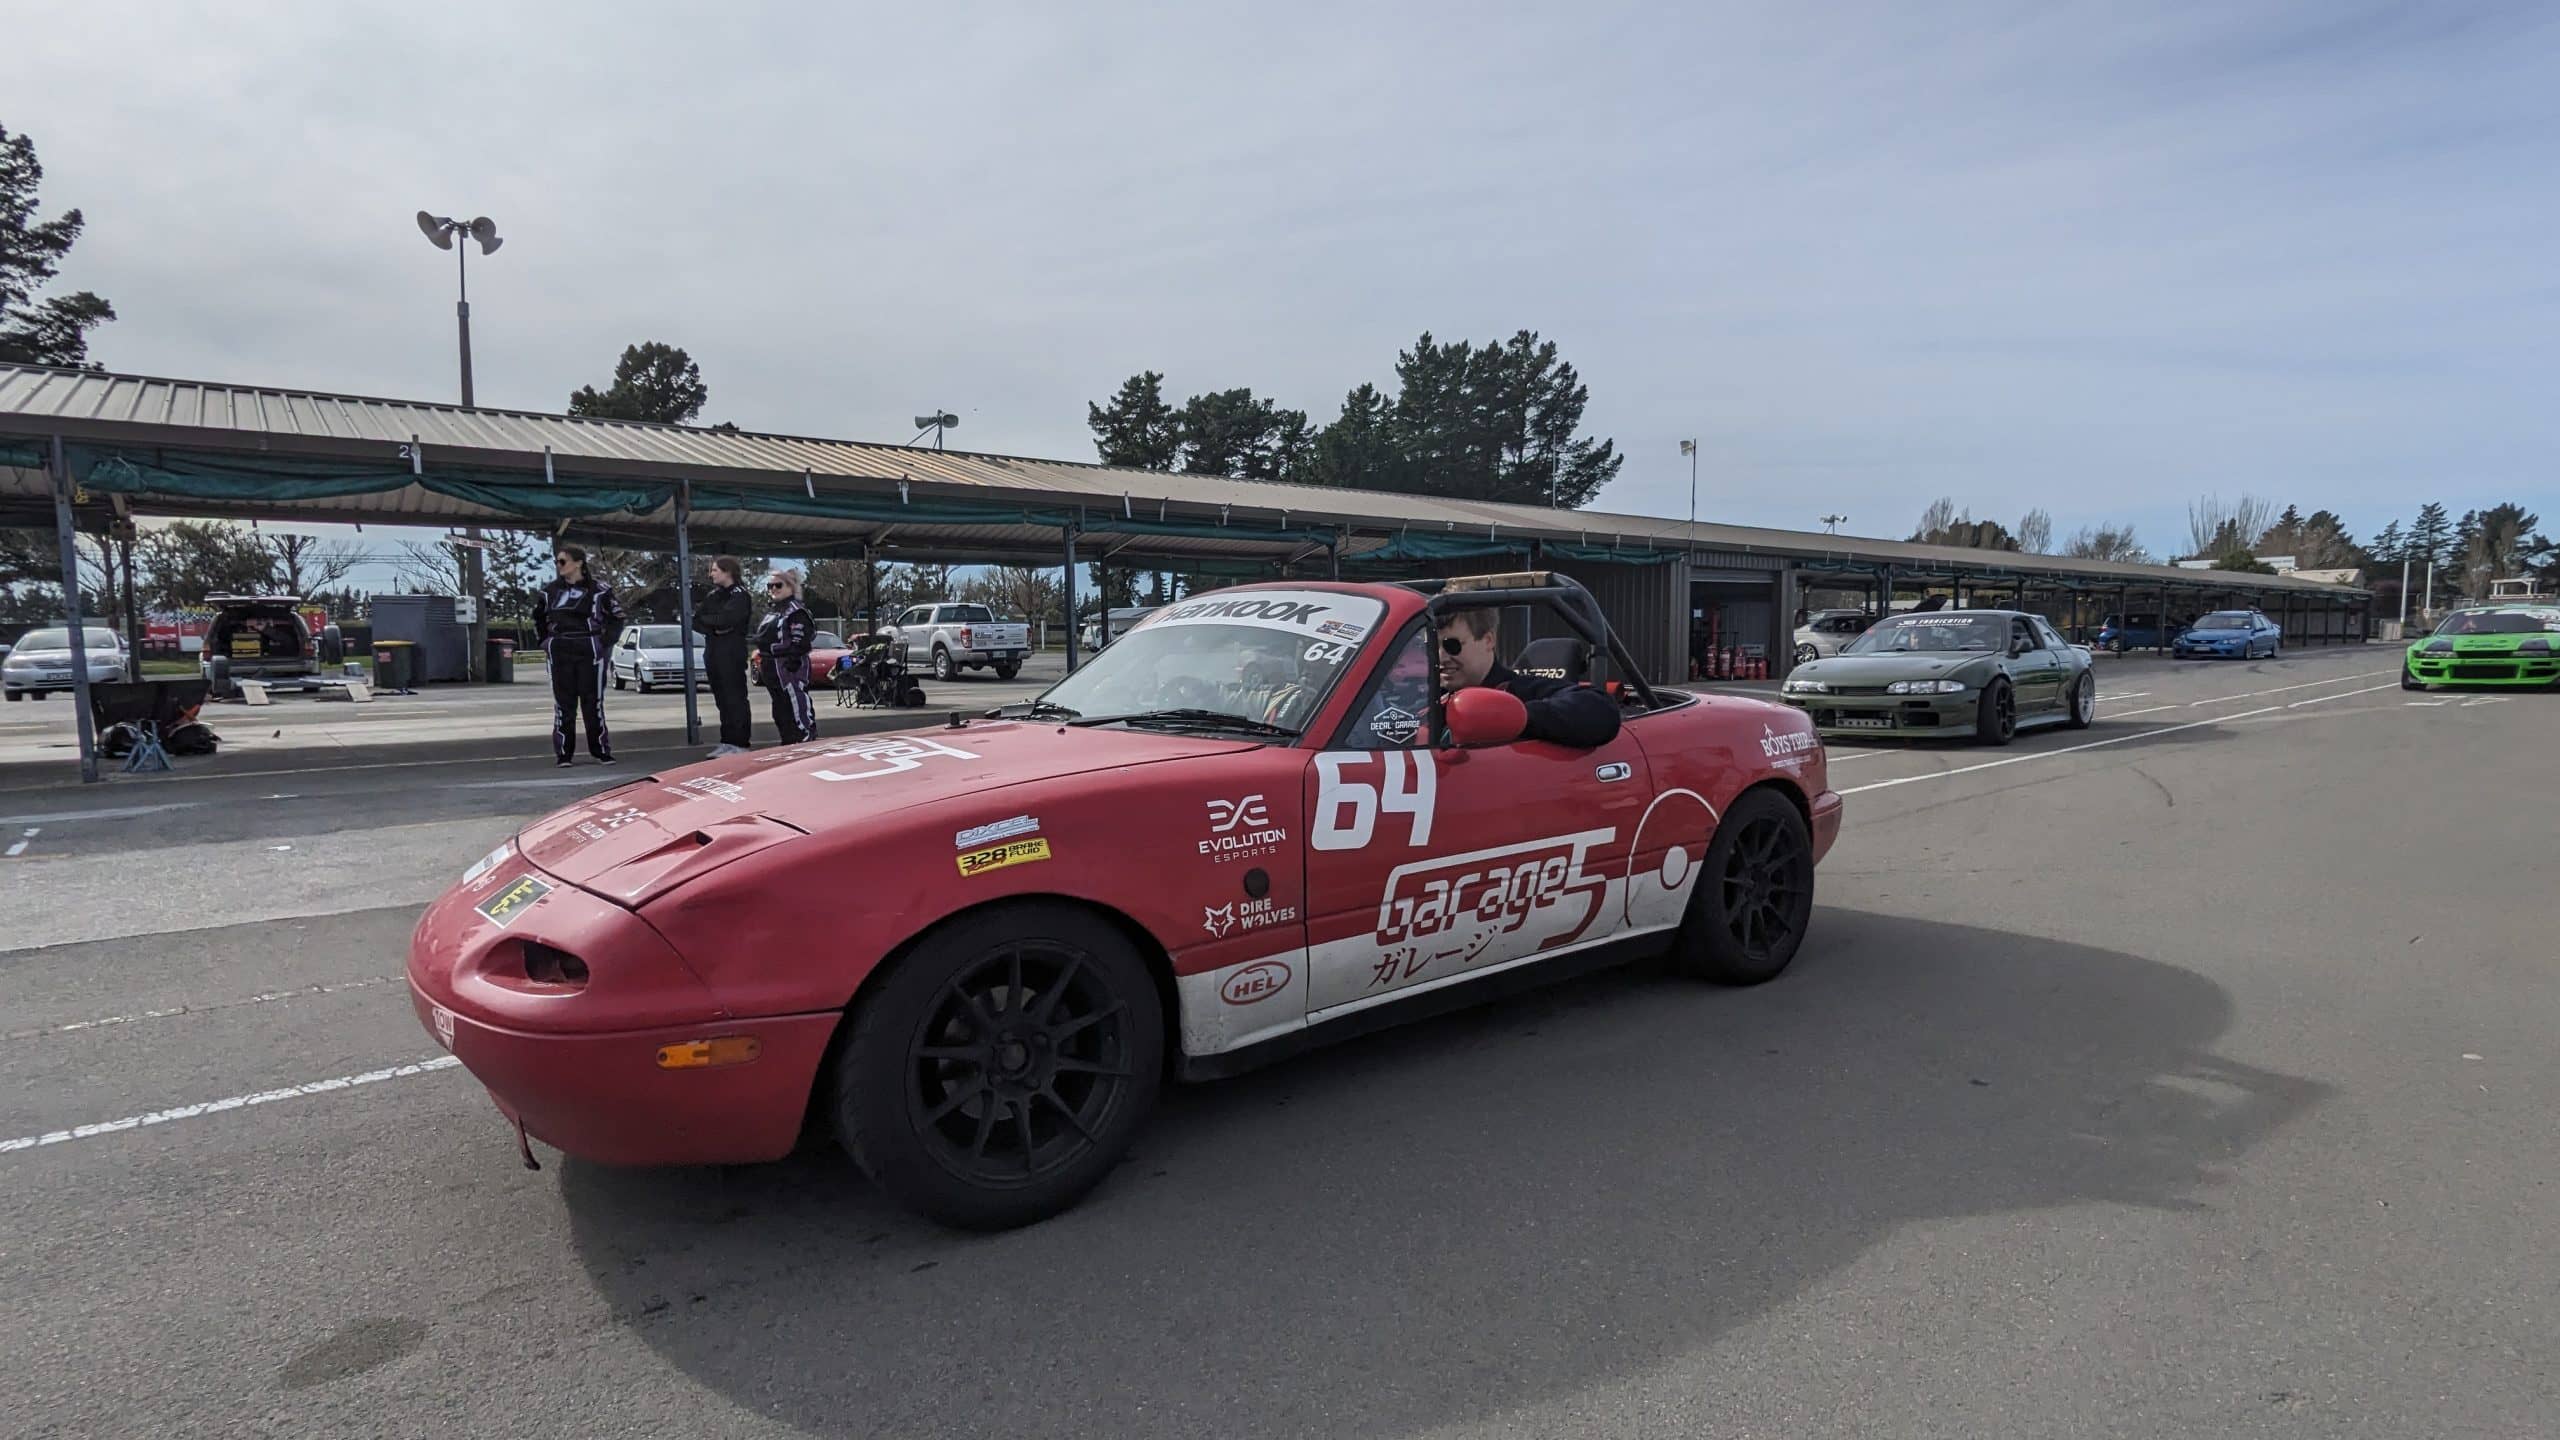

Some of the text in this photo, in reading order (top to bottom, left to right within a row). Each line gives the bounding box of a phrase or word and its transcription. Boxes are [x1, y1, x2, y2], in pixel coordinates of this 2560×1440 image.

[1304, 642, 1347, 664] 64
[1370, 721, 1391, 730] DECAL
[1760, 734, 1791, 757] BOYS
[1311, 749, 1437, 851] 64
[1008, 840, 1044, 852] BRAKE
[1009, 847, 1040, 857] FLUID
[1199, 828, 1287, 854] EVOLUTION
[962, 847, 1007, 870] 328
[1214, 846, 1276, 863] ESPORTS
[1240, 898, 1272, 915] DIRE
[1241, 907, 1296, 930] WOLVES
[1368, 925, 1498, 989] ガレージ
[1234, 976, 1279, 998] HEL
[432, 1006, 454, 1035] TOW
